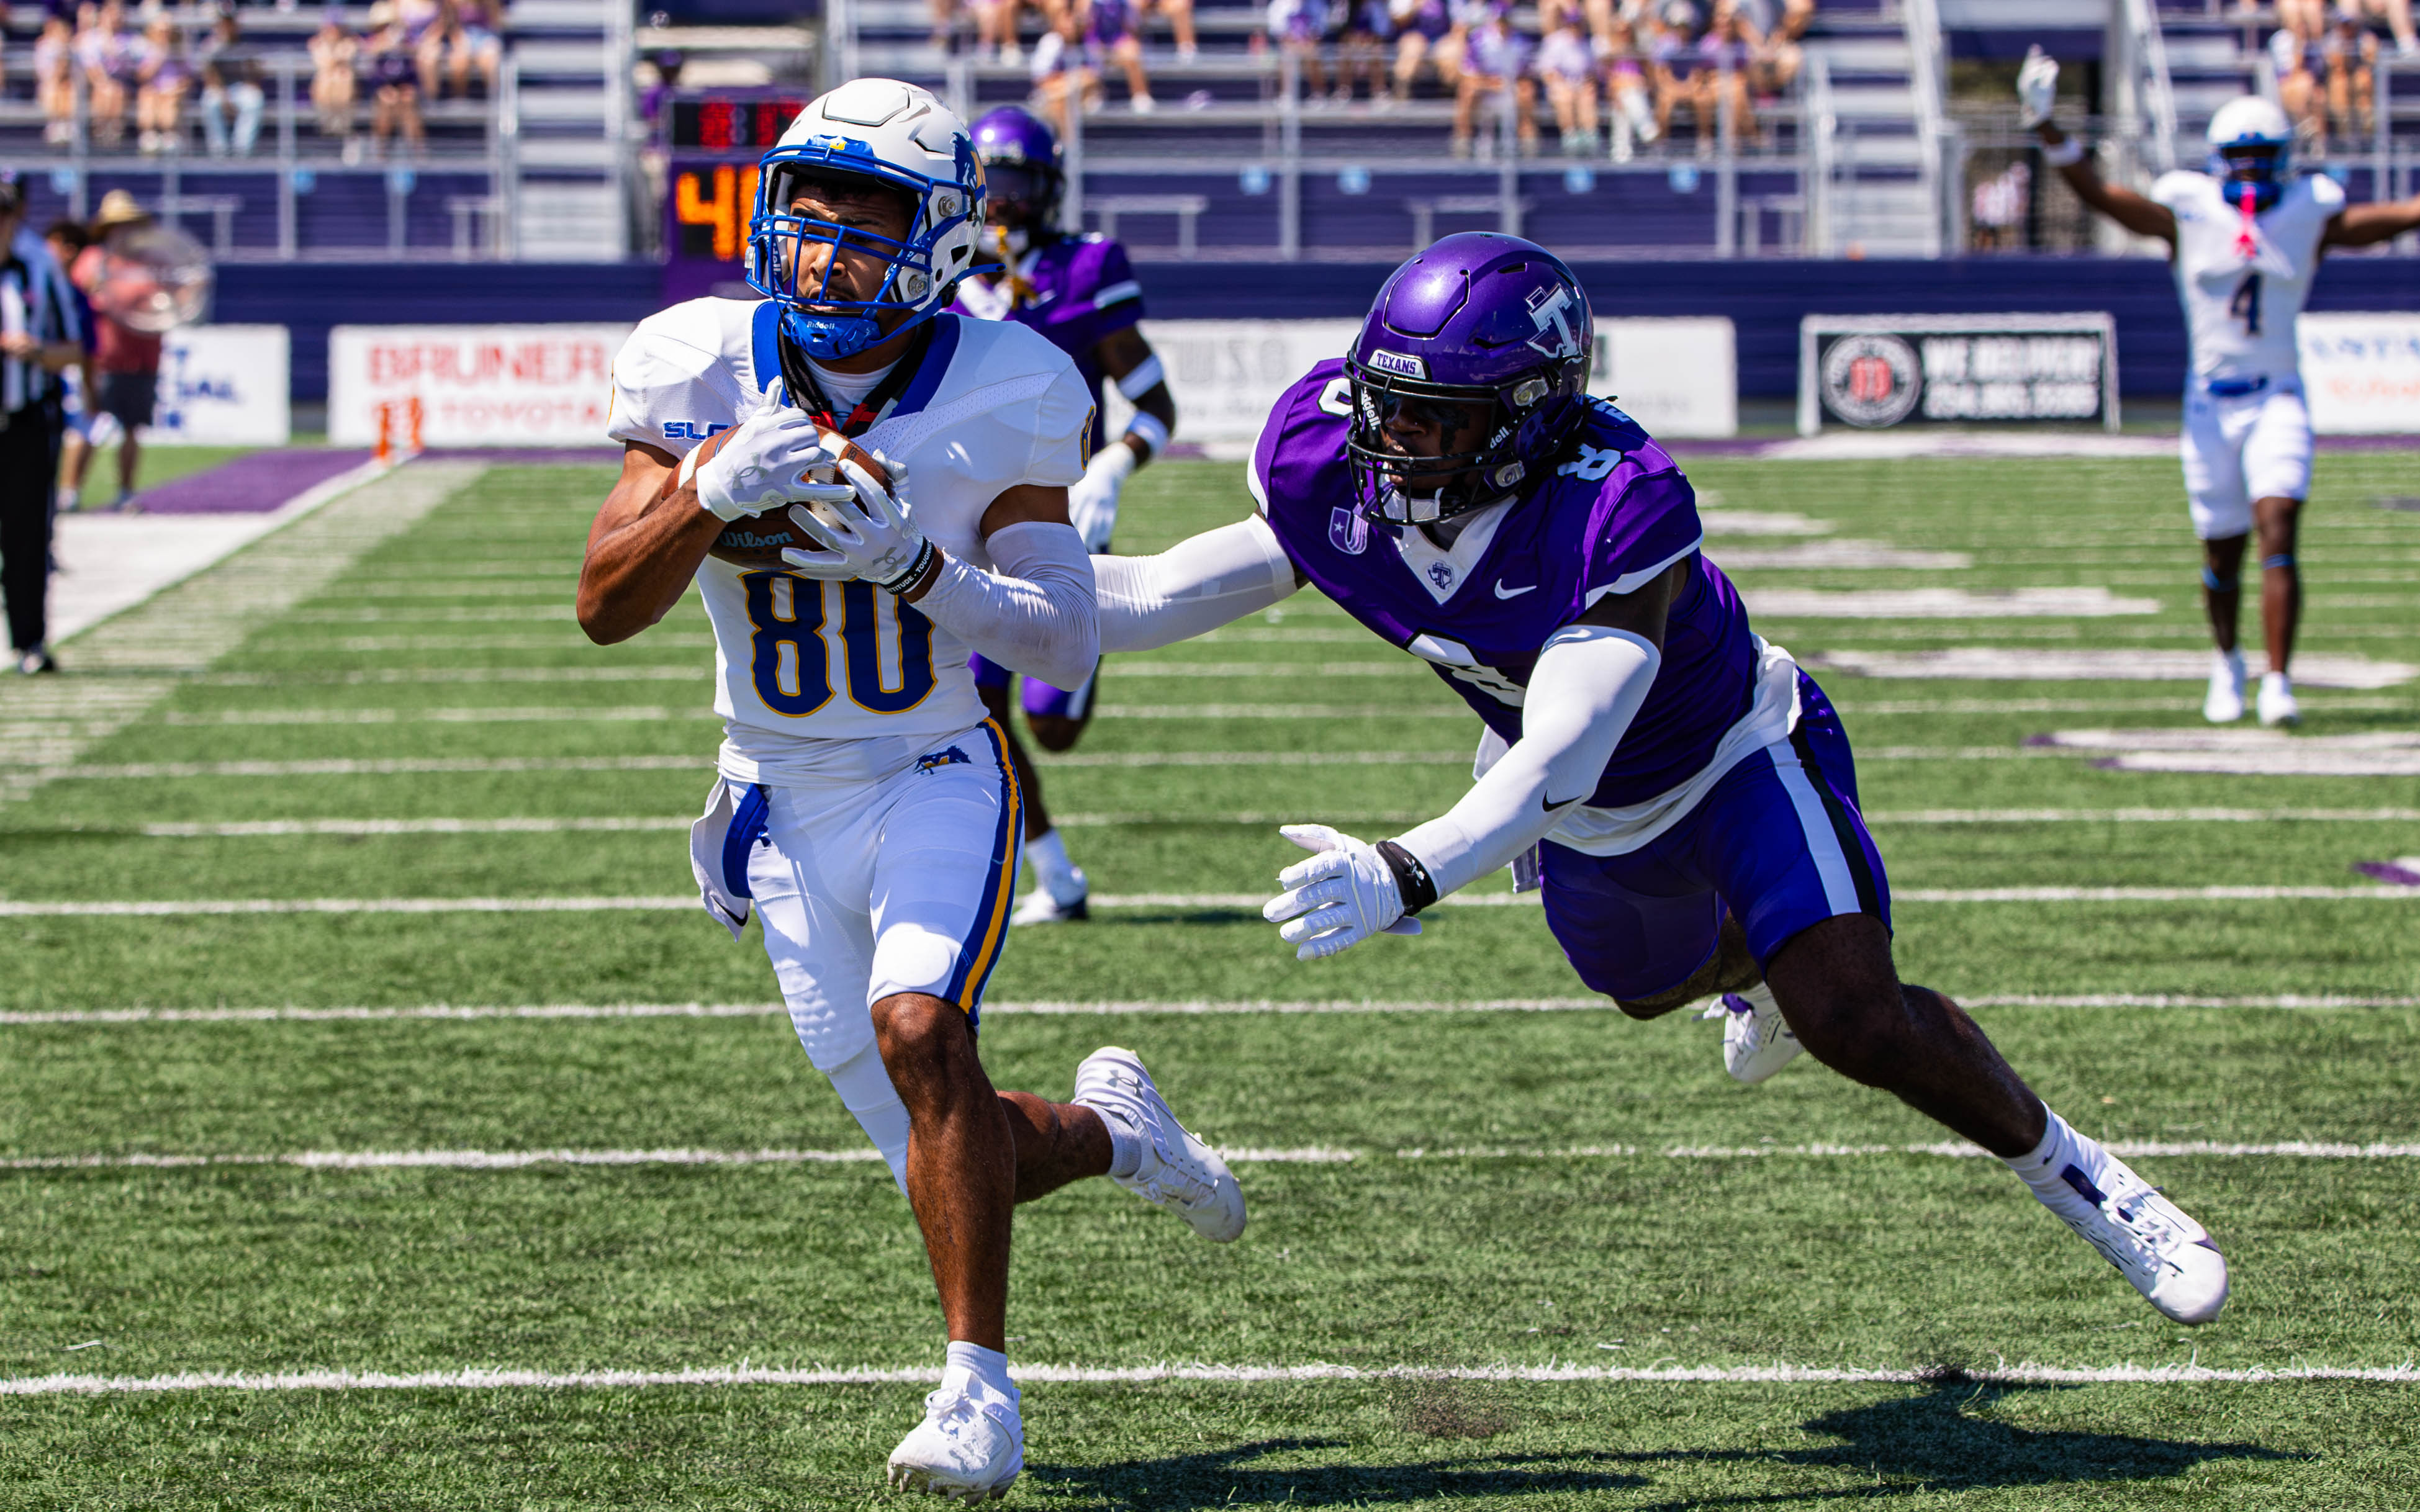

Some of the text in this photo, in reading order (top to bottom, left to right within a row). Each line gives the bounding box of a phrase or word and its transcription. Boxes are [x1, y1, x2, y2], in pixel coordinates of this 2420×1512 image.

[2231, 271, 2264, 336] 4
[369, 343, 607, 385] BRUNER
[1376, 353, 1416, 375] TEXANS
[720, 531, 794, 548] Wilson
[737, 569, 939, 718] 80
